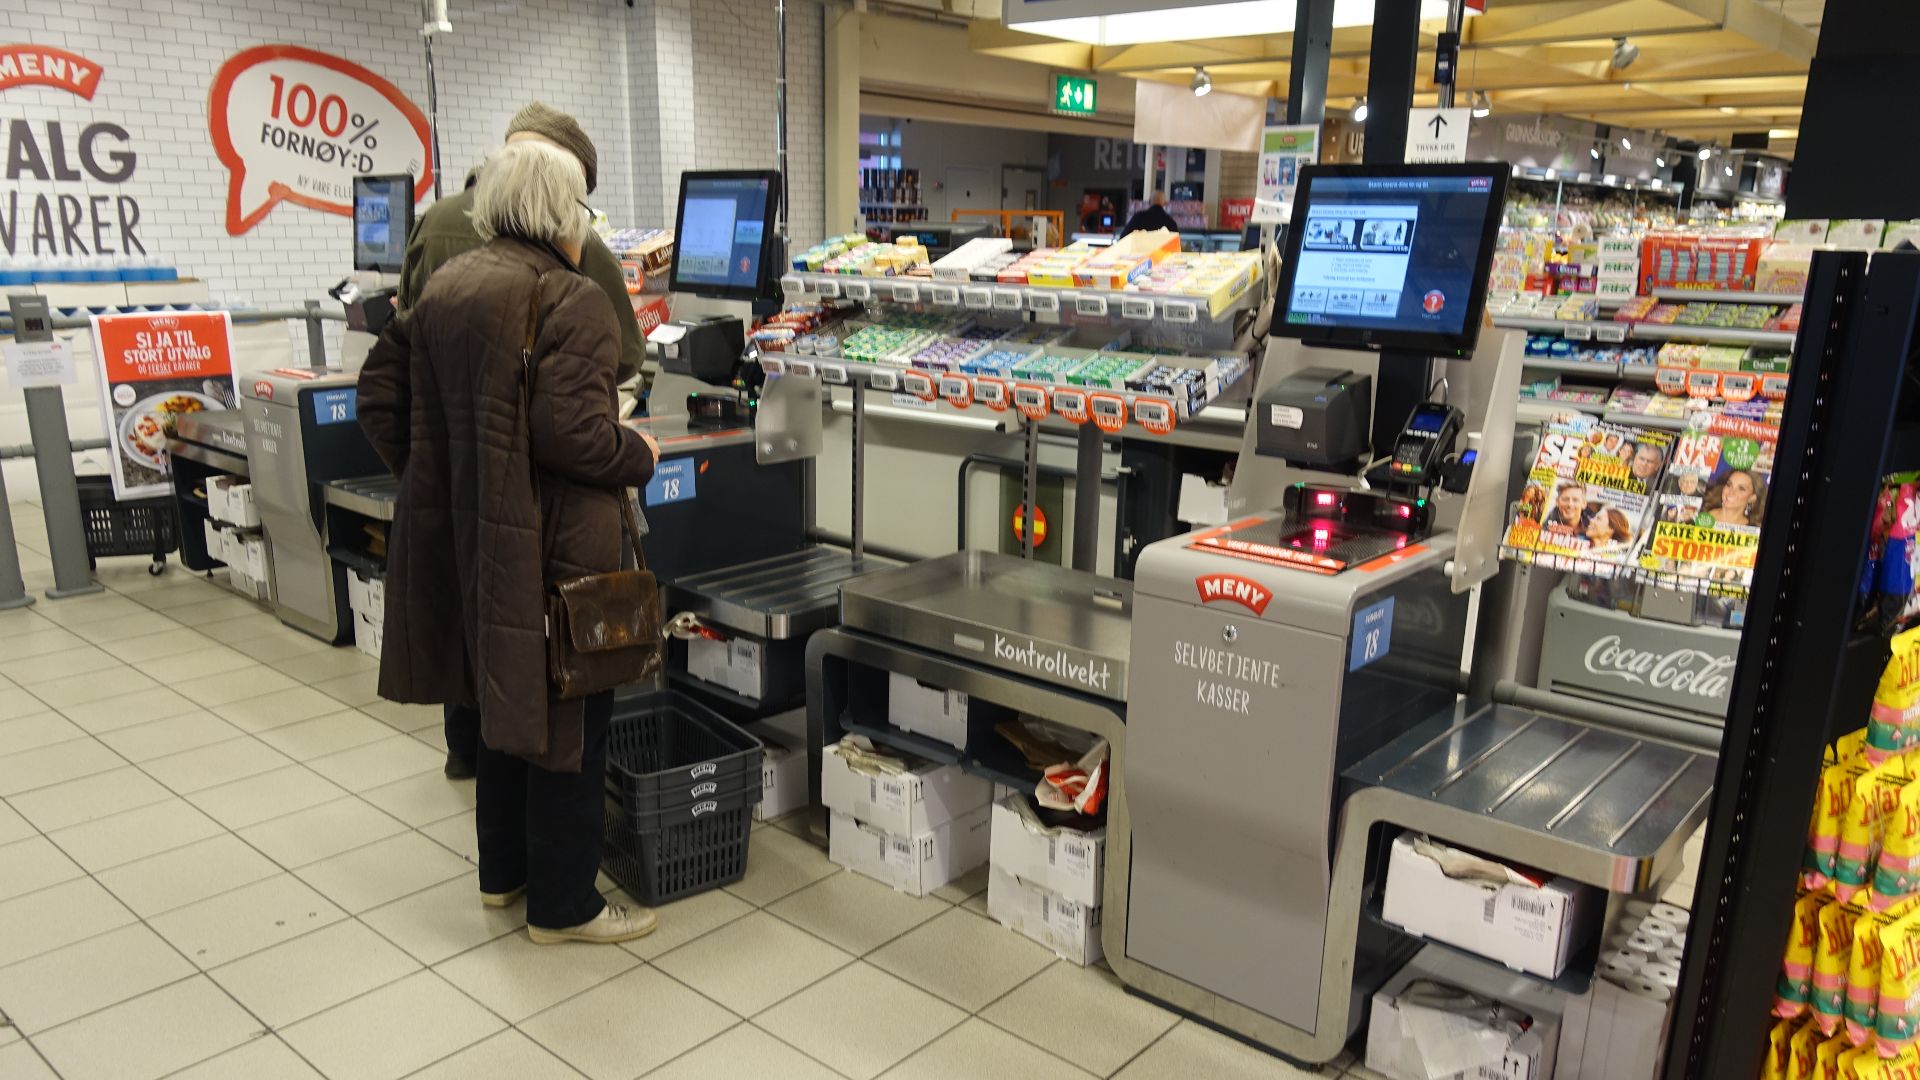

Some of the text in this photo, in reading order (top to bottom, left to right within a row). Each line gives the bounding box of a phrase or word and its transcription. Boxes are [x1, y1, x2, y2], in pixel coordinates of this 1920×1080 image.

[270, 73, 378, 150] 100%
[0, 119, 137, 183] ALG
[261, 123, 375, 174] FORNØY:D
[297, 174, 309, 187] NY
[312, 177, 331, 195] VARE
[136, 329, 197, 349] SI JA TIL
[124, 345, 212, 365] STORT UTVALG
[1752, 359, 1776, 370] Dent
[330, 403, 347, 420] 18
[663, 479, 680, 501] 18
[1597, 475, 1645, 493] FAMILIEN
[1658, 524, 1695, 541] KATE
[1204, 578, 1265, 606] MENY
[1364, 628, 1380, 663] 18
[994, 633, 1111, 691] Kontrollvekt
[1174, 640, 1281, 689] SELVBETJENTE
[1197, 679, 1251, 715] KASSER
